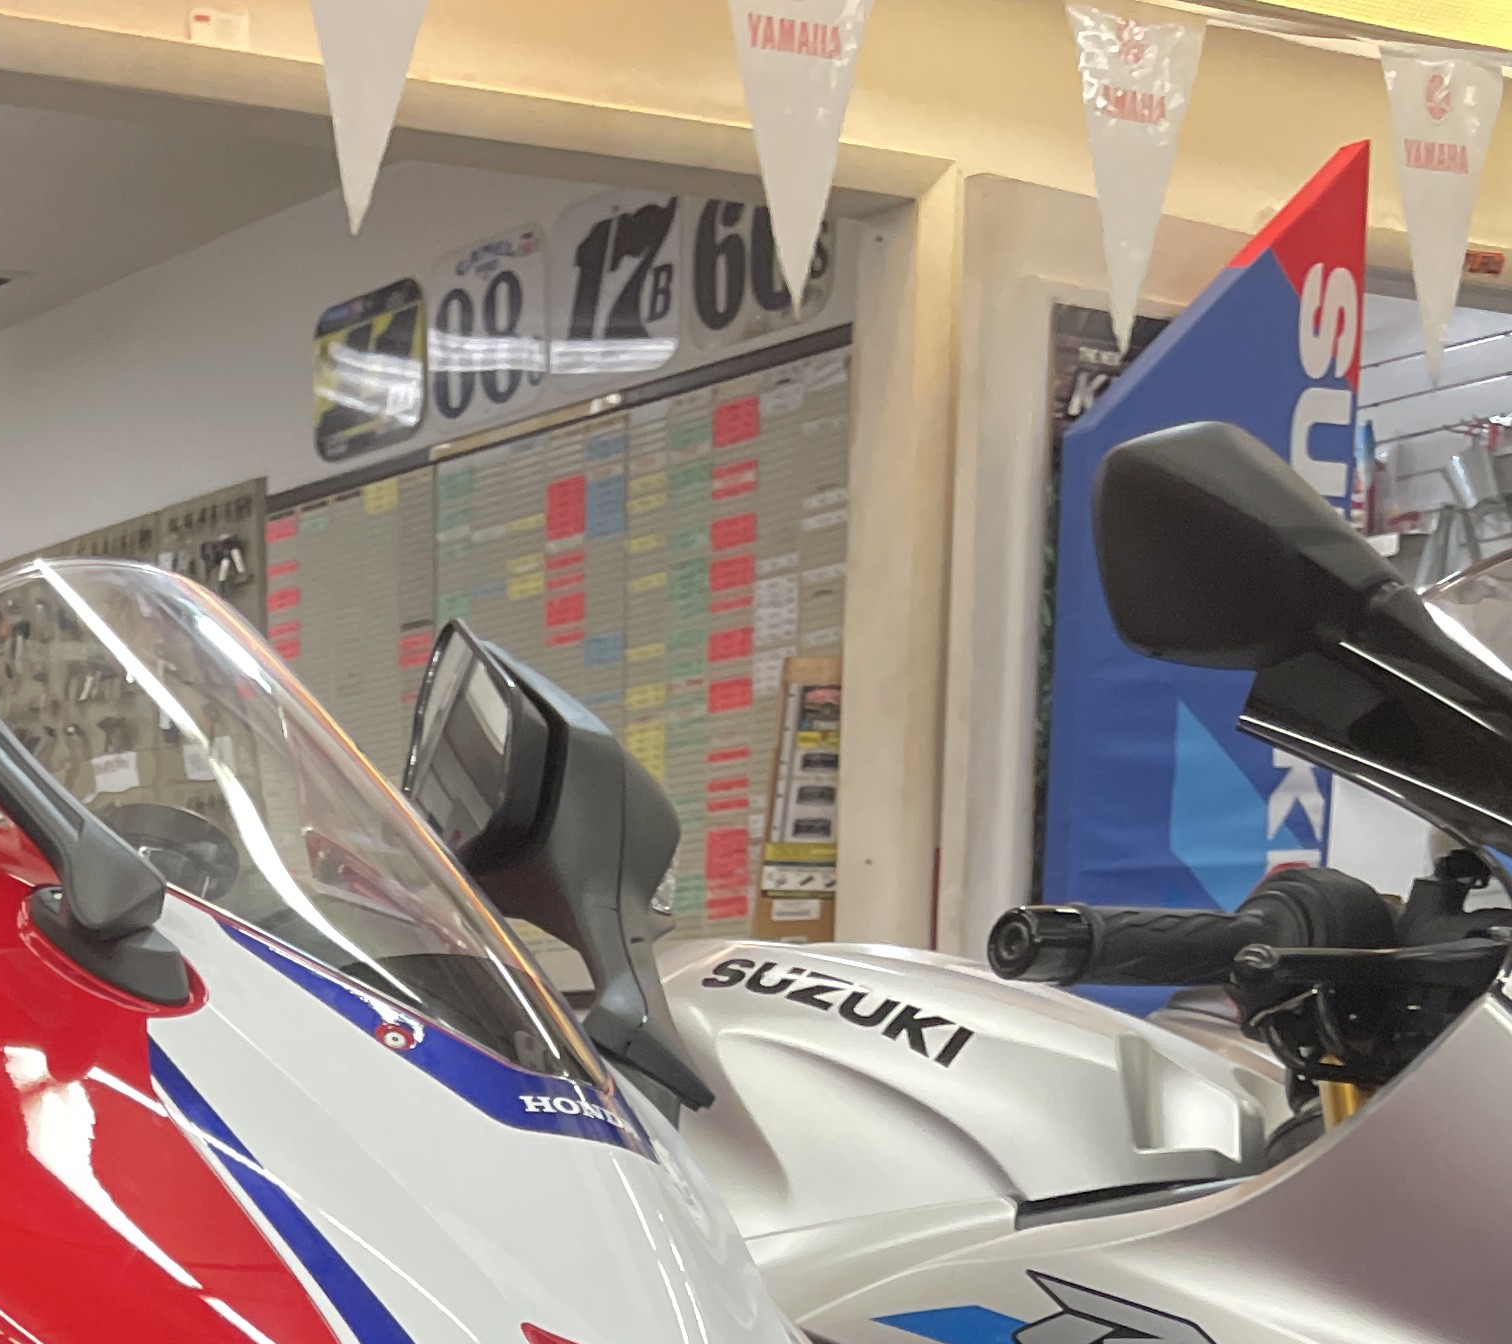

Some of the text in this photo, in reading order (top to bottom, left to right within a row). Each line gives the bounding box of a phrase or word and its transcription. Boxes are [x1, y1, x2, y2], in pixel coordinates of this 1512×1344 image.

[747, 11, 841, 60] YAMAHA
[1404, 138, 1469, 175] YAMAHA
[701, 958, 976, 1069] SUZUKI
